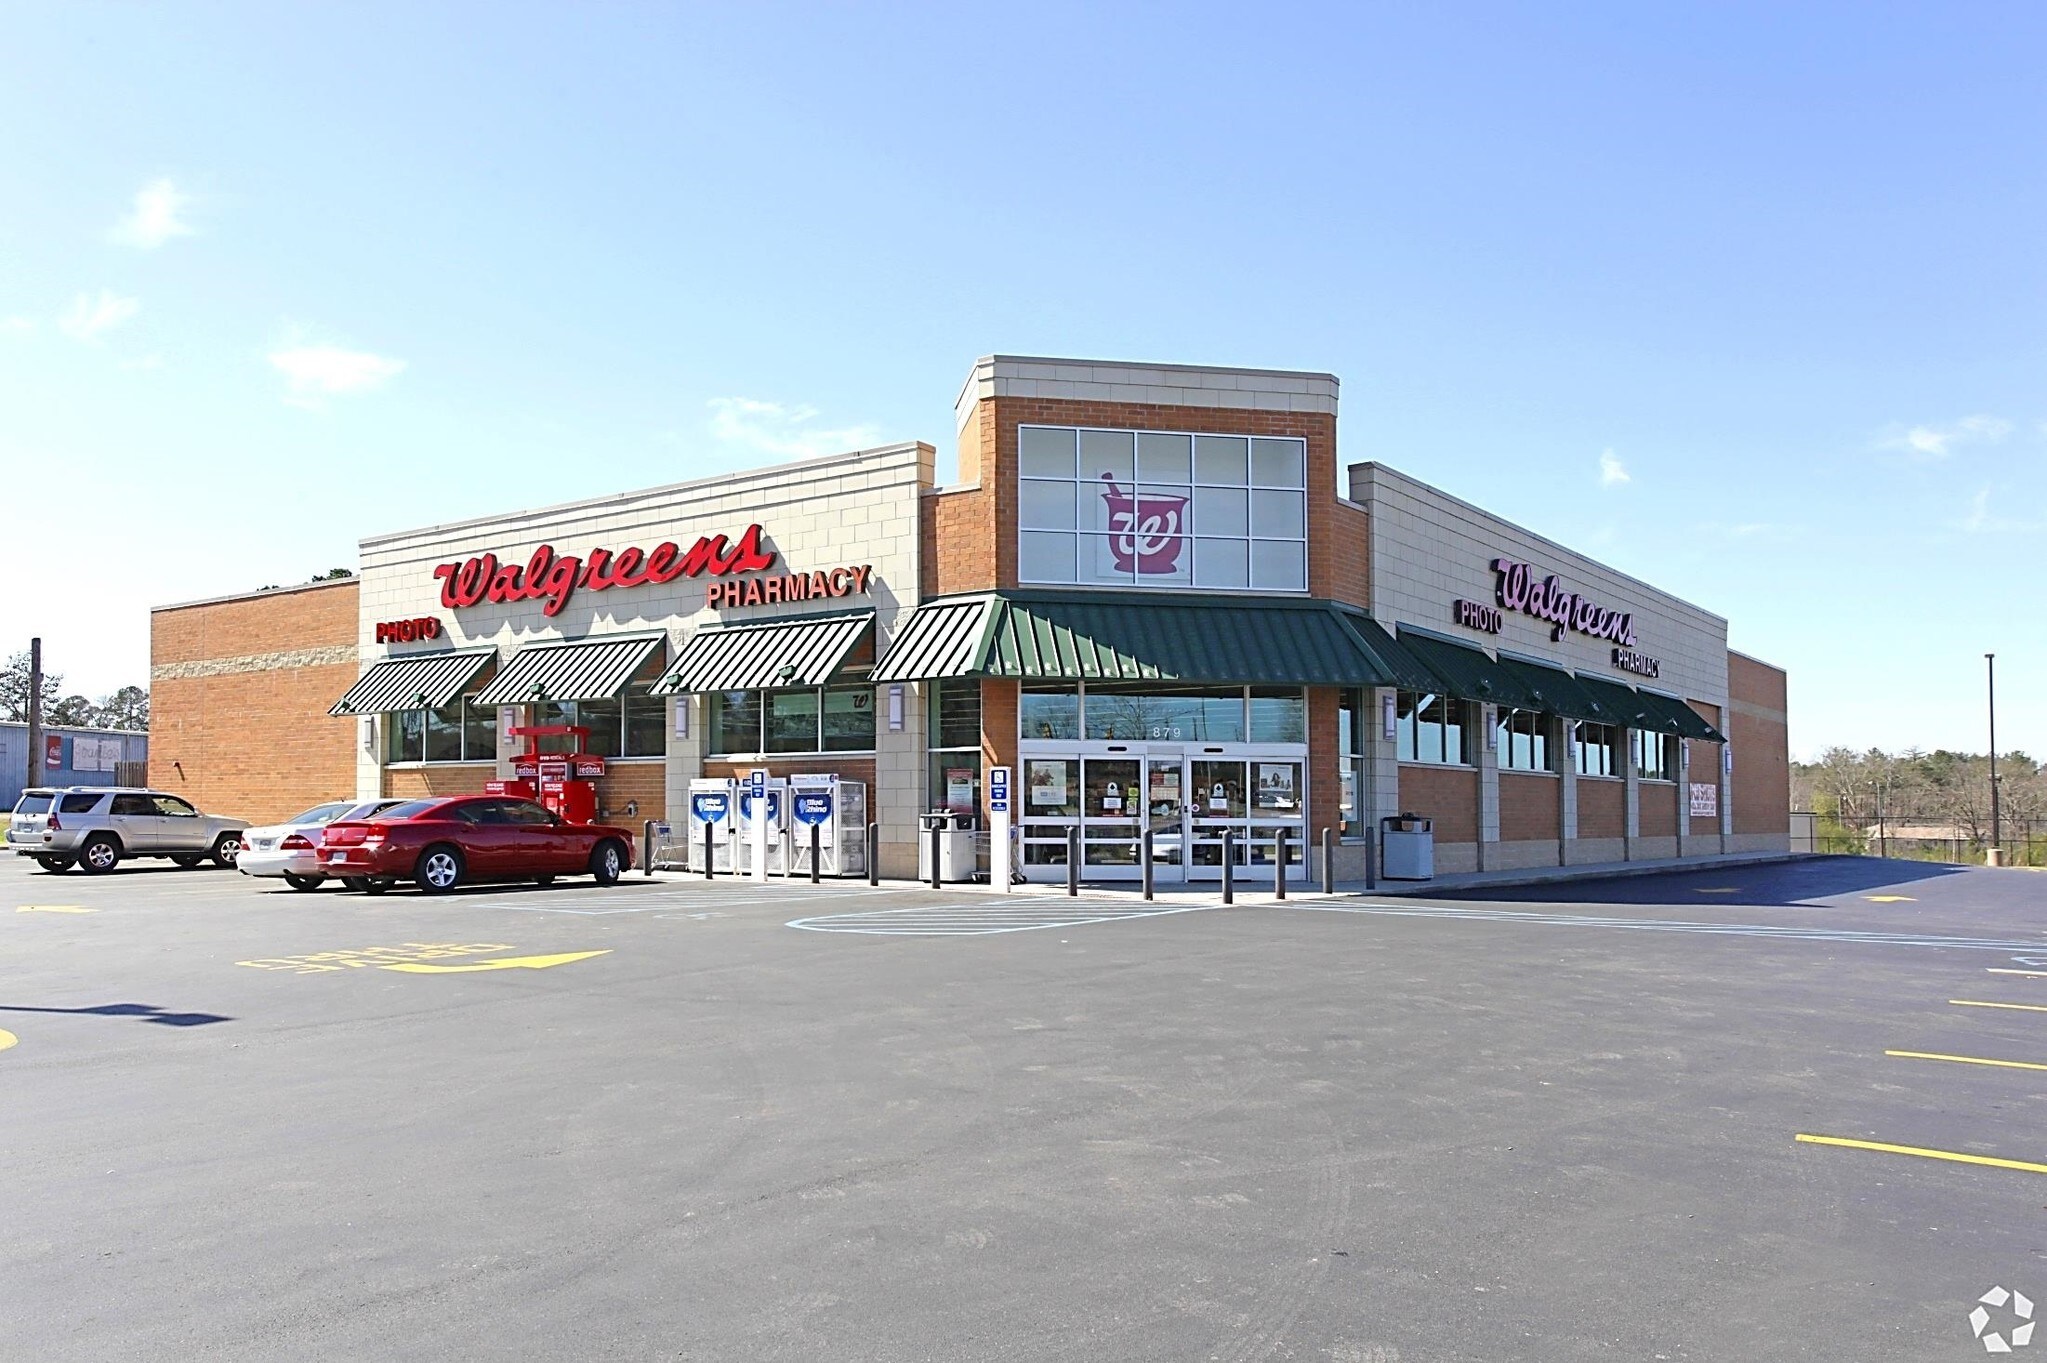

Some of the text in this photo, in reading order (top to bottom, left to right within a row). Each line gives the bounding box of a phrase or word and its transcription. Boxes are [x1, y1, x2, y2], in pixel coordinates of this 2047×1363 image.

[434, 523, 777, 618] Walgreens
[706, 564, 873, 609] PHARMACY
[1457, 600, 1505, 635] PHOTO
[1491, 558, 1638, 647] Walgreens
[376, 616, 441, 644] PHOTO
[1614, 649, 1661, 679] PHARMACY
[1153, 727, 1181, 738] 879
[516, 766, 537, 775] redbox
[579, 766, 601, 774] redbox
